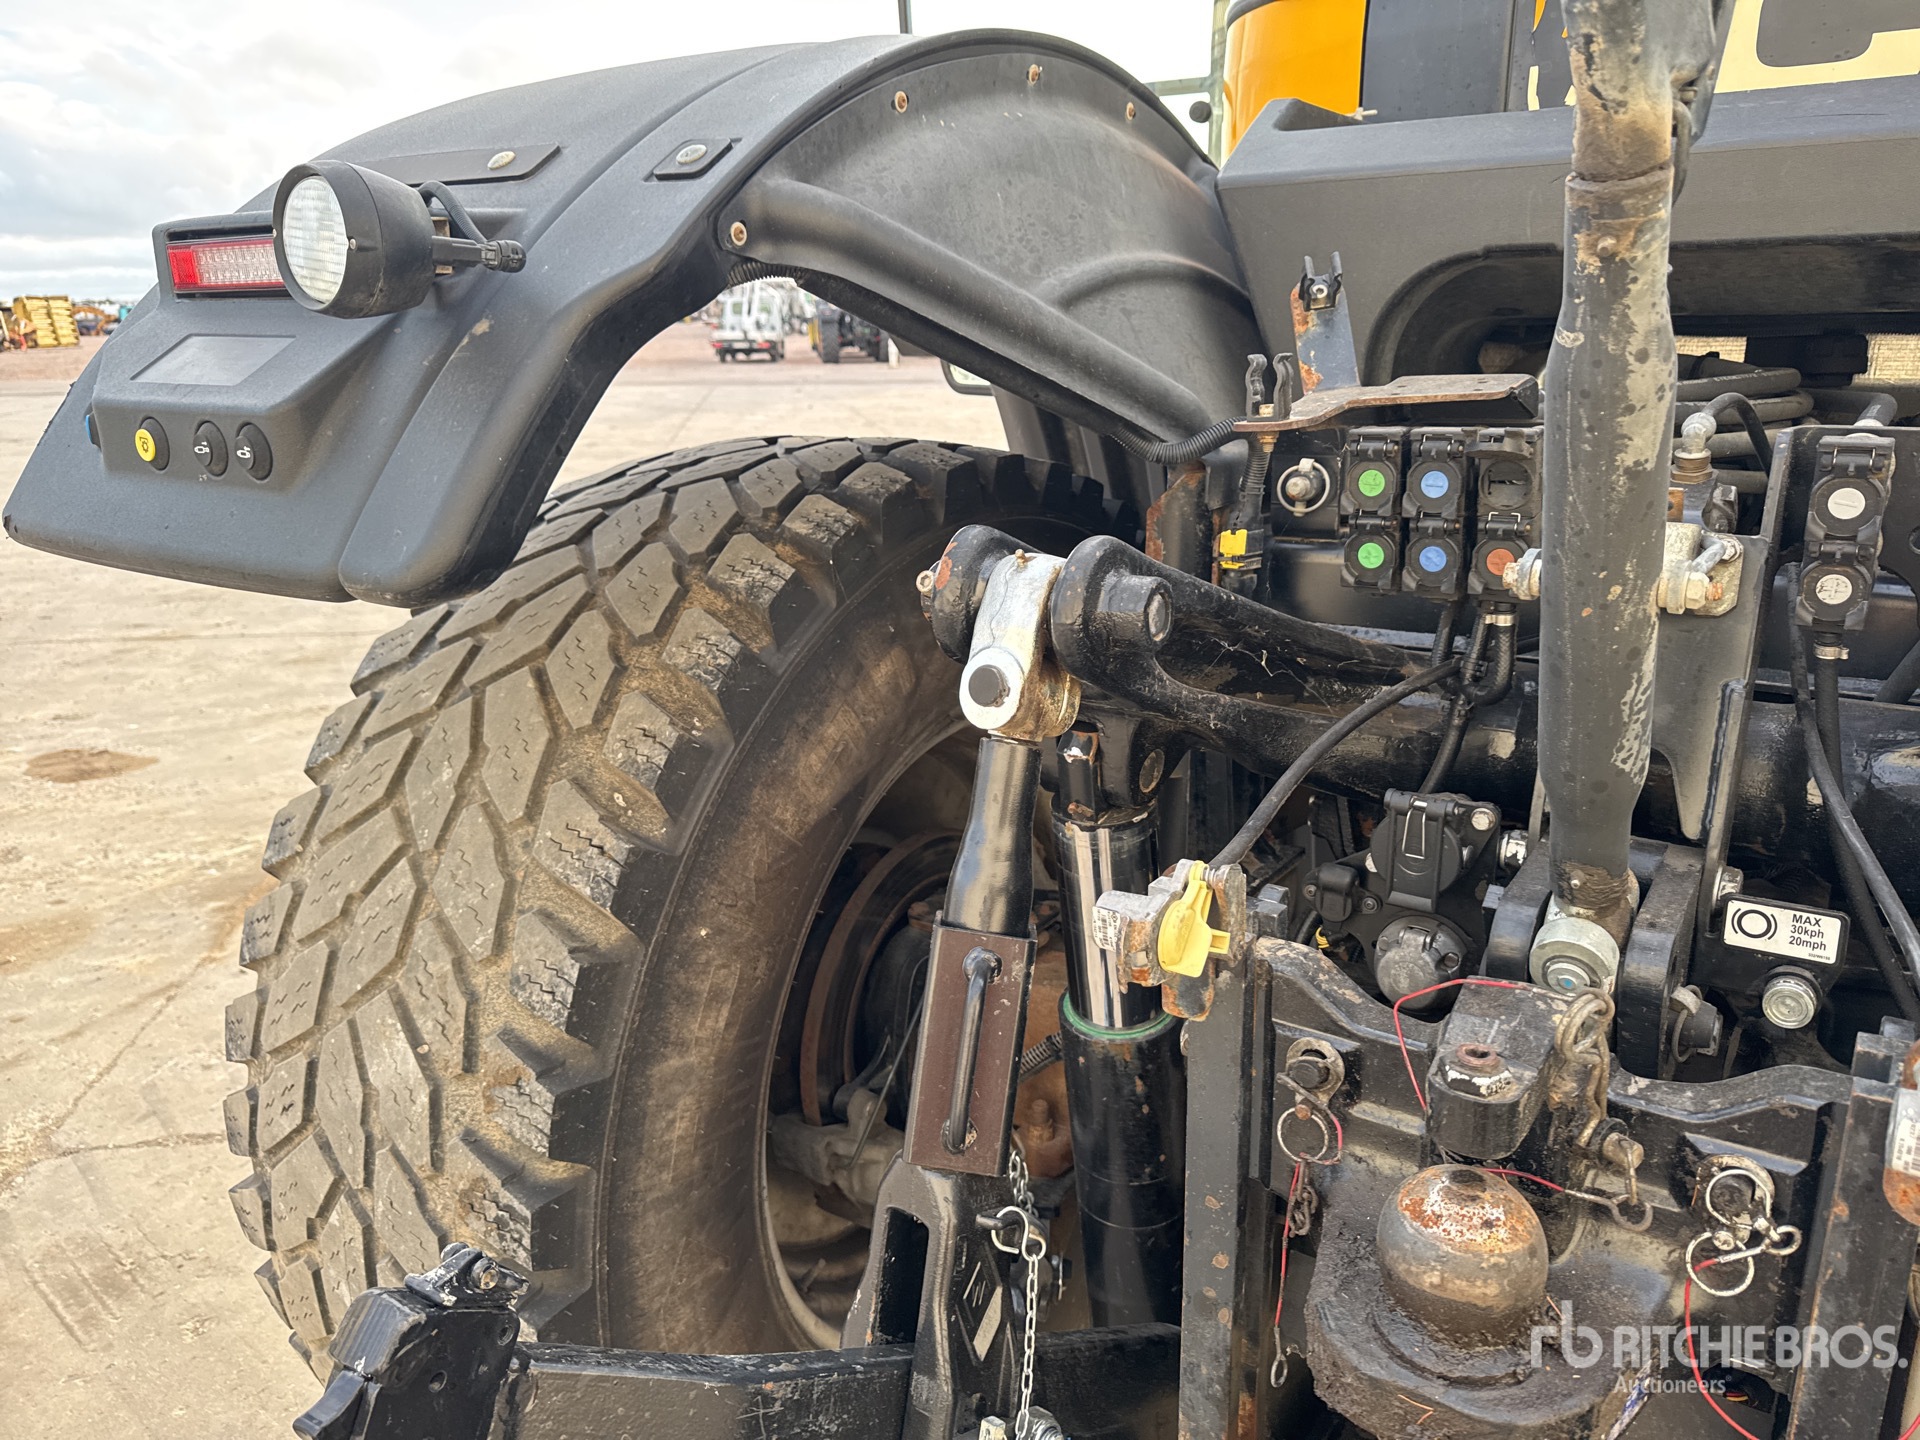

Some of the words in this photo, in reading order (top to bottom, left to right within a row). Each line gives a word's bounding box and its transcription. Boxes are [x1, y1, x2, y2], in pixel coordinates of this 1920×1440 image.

[1791, 913, 1822, 928] MAX
[1790, 924, 1824, 939] 30kph
[1788, 935, 1827, 951] 20mph
